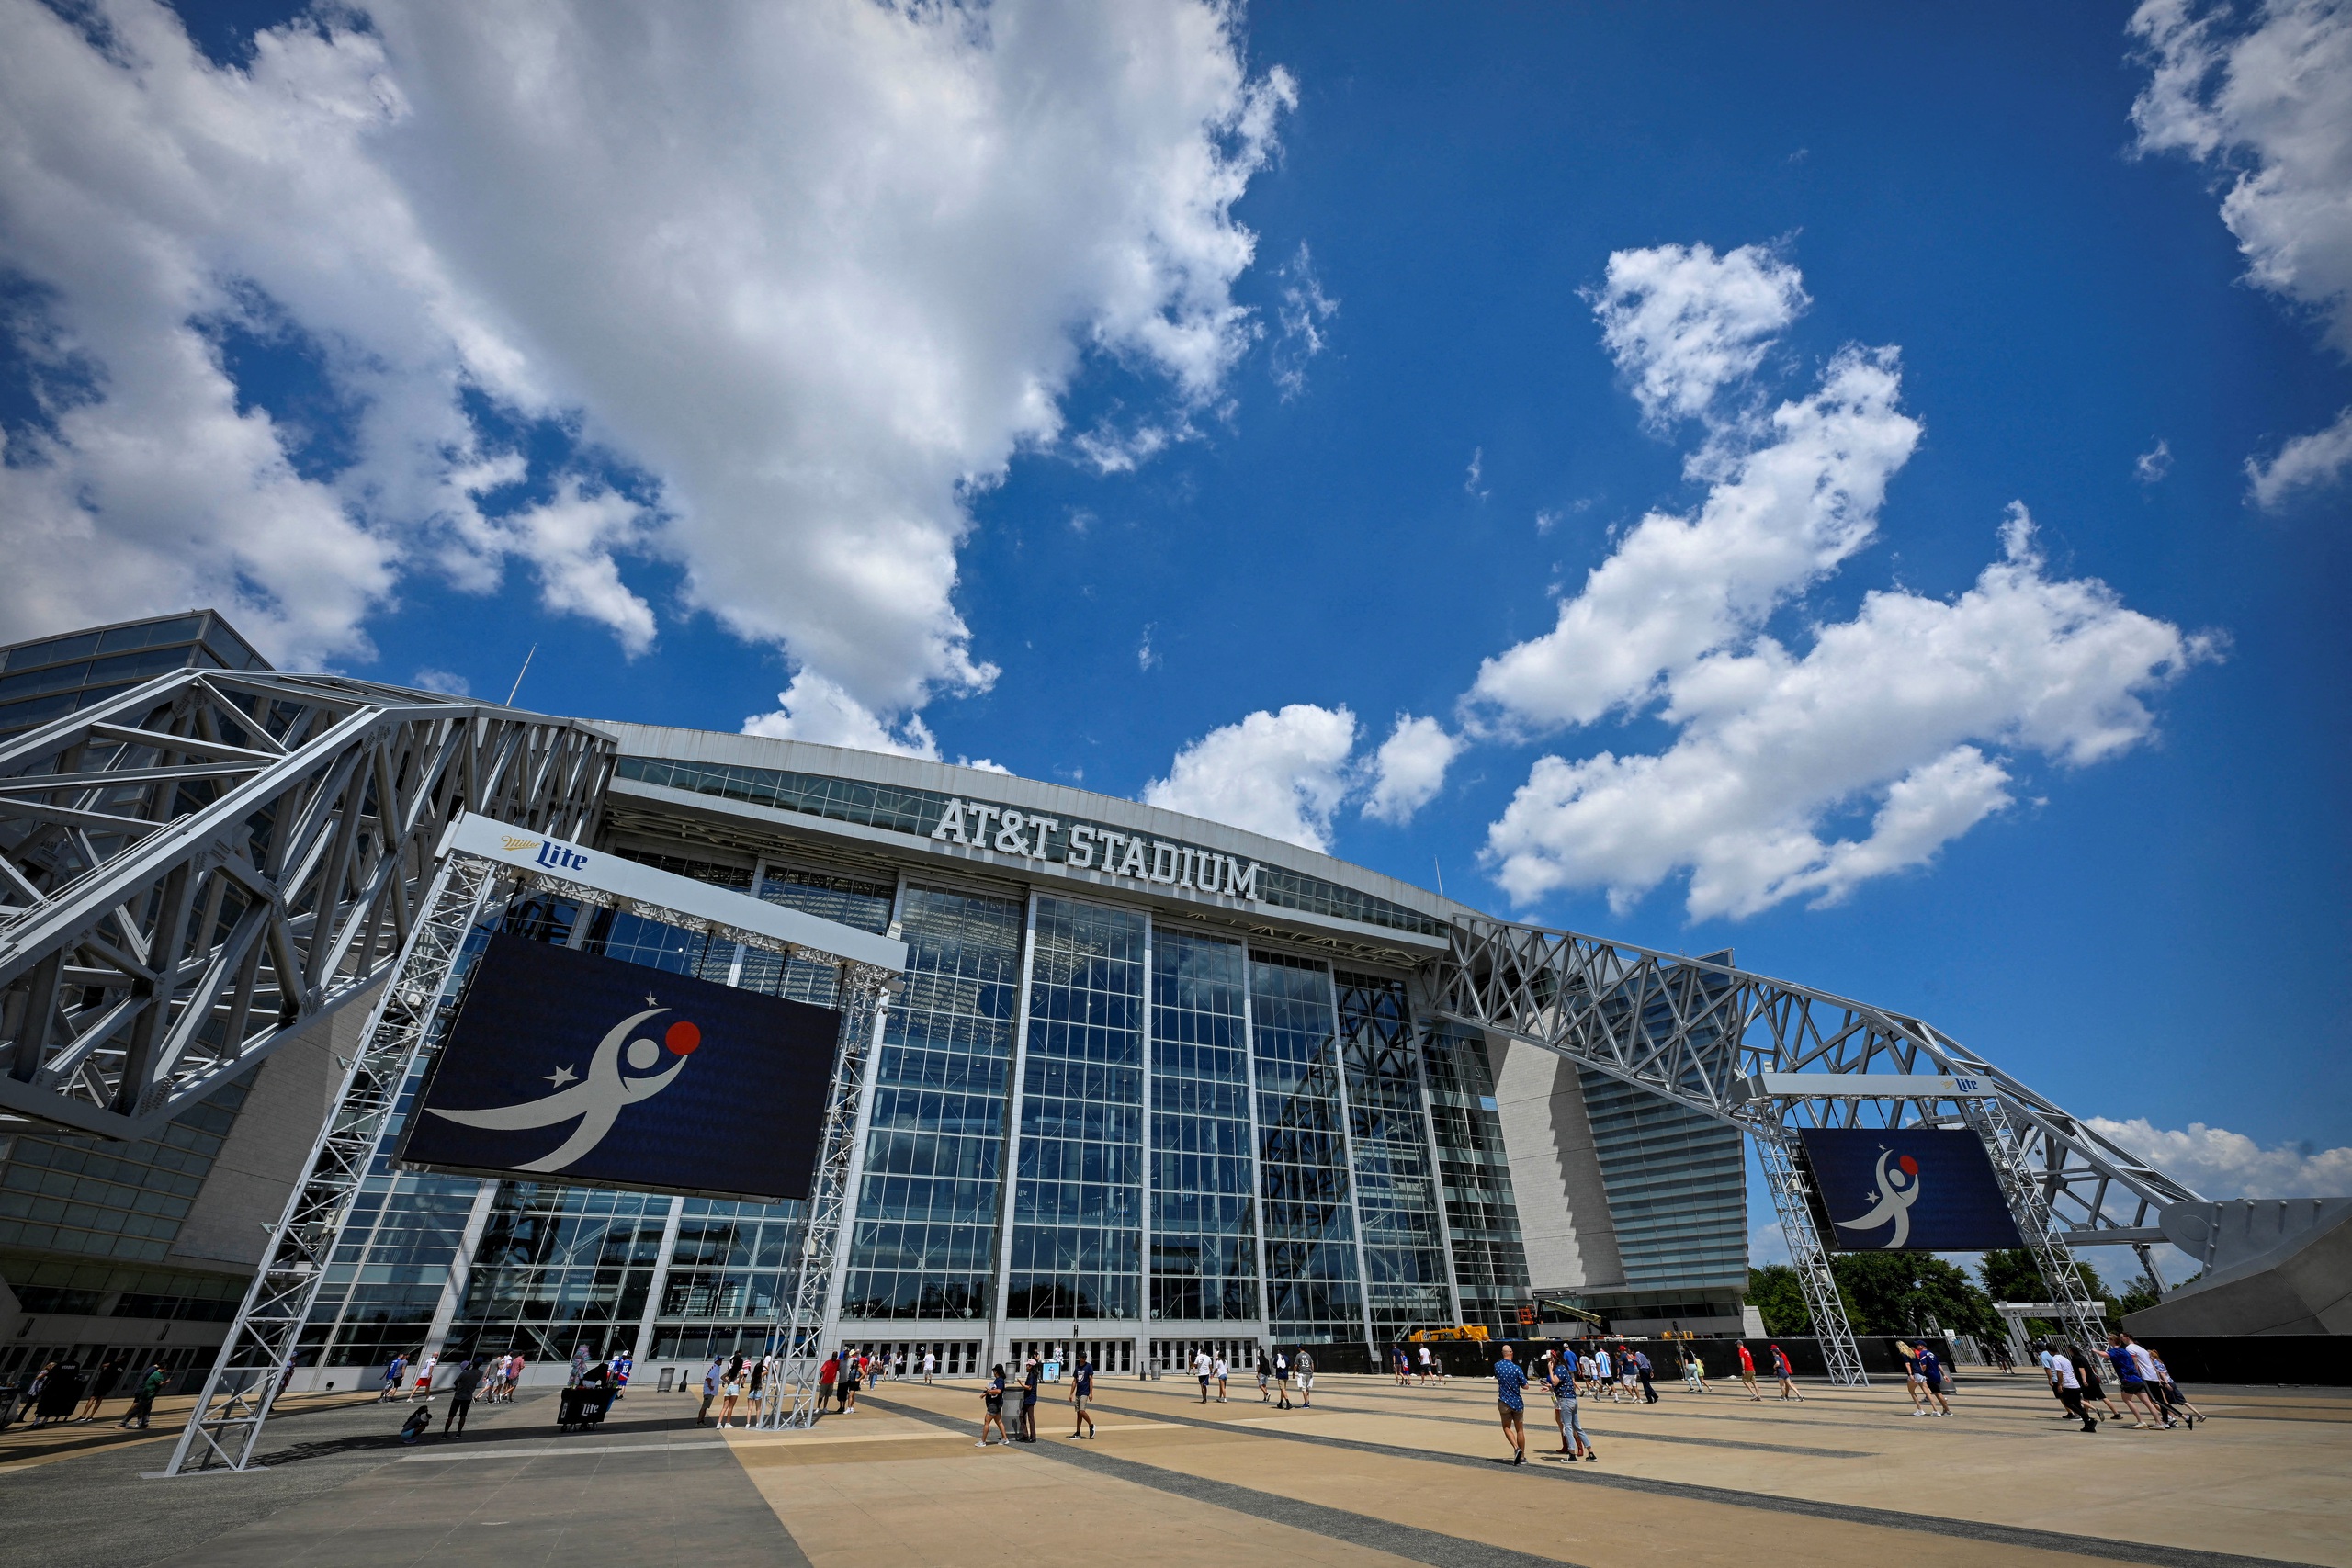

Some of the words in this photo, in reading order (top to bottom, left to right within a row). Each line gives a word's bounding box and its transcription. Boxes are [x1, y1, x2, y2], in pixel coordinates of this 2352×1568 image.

[501, 835, 541, 849] Miller
[534, 840, 588, 871] Lite
[931, 797, 1058, 860] AT&T
[1067, 824, 1261, 901] STADIUM
[1954, 1077, 1978, 1092] Lite
[1073, 1325, 1079, 1337] H
[581, 1404, 599, 1416] Lite
